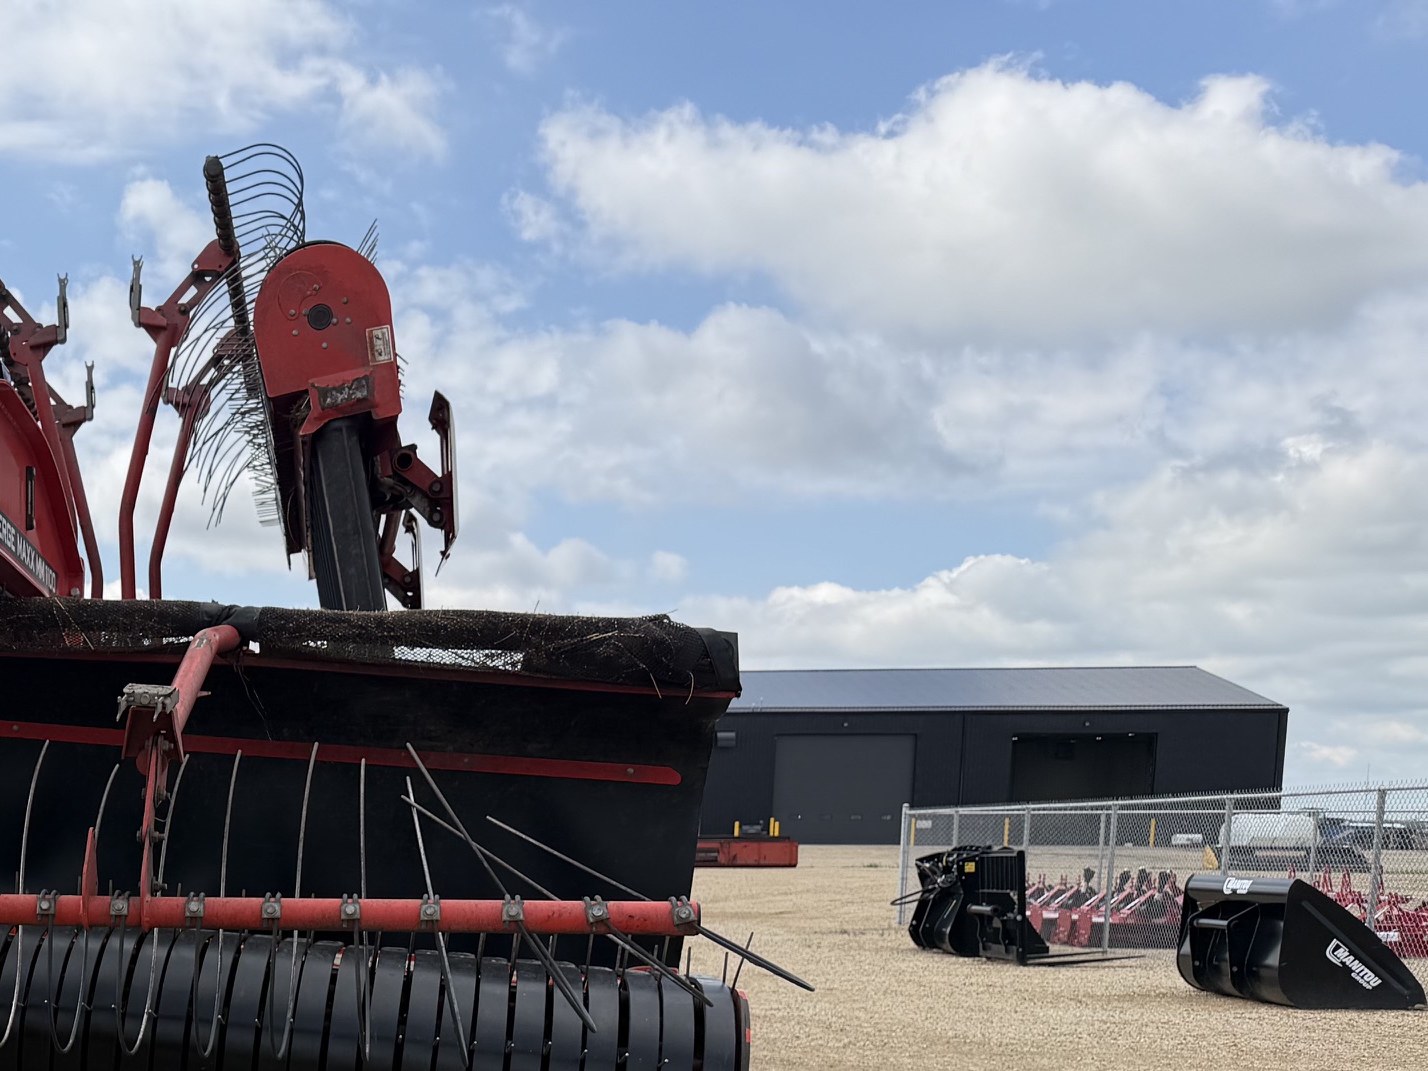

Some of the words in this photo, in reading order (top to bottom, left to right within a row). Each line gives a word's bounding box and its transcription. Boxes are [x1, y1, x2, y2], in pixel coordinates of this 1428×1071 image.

[16, 533, 36, 573] MAXX
[45, 564, 56, 594] 1100
[1333, 947, 1383, 987] MANITOU
